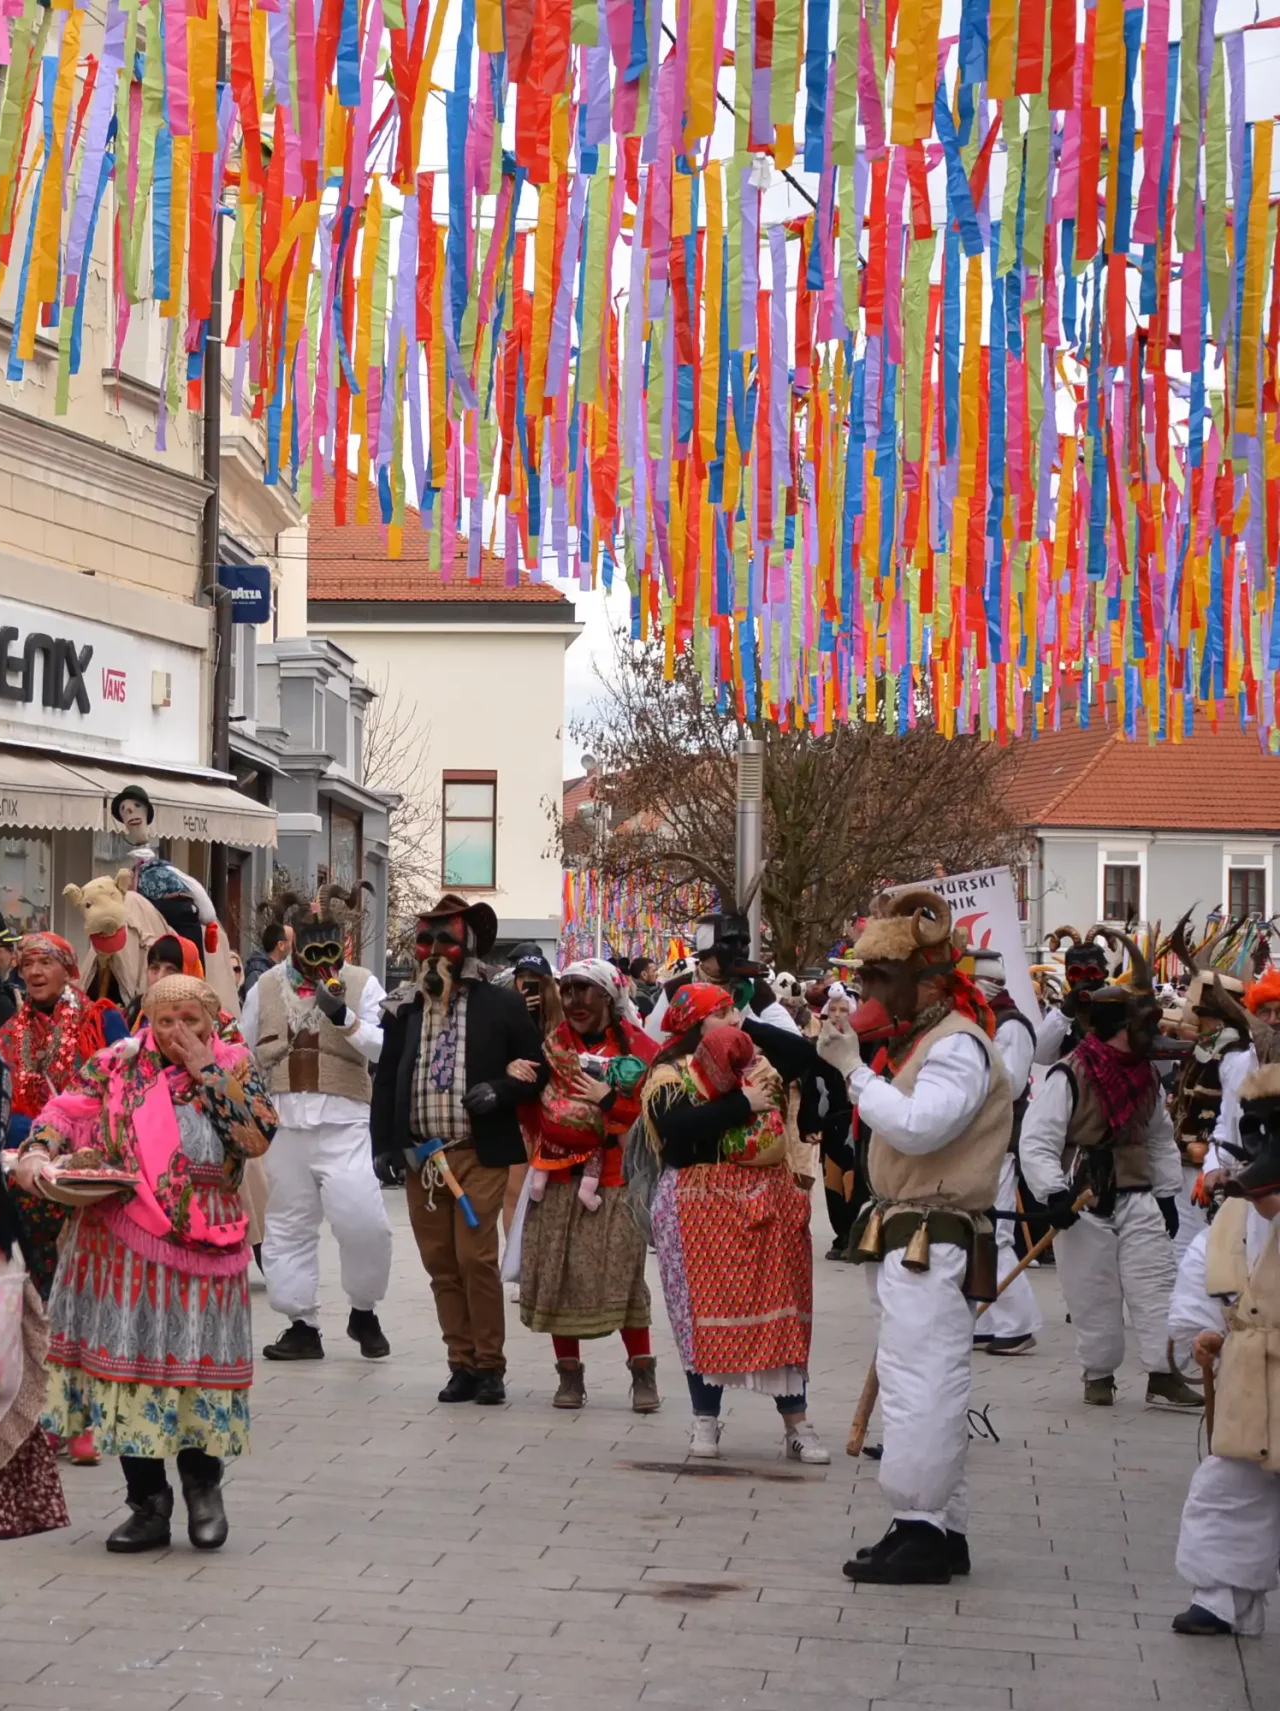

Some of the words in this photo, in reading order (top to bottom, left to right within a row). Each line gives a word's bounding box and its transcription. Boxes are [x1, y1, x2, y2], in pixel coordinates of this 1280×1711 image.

[231, 587, 262, 599] VAZZA
[102, 667, 126, 703] VANS
[183, 815, 208, 833] FENIX
[926, 875, 996, 896] MURSKI
[947, 896, 977, 911] NIK
[518, 955, 542, 966] POLICE
